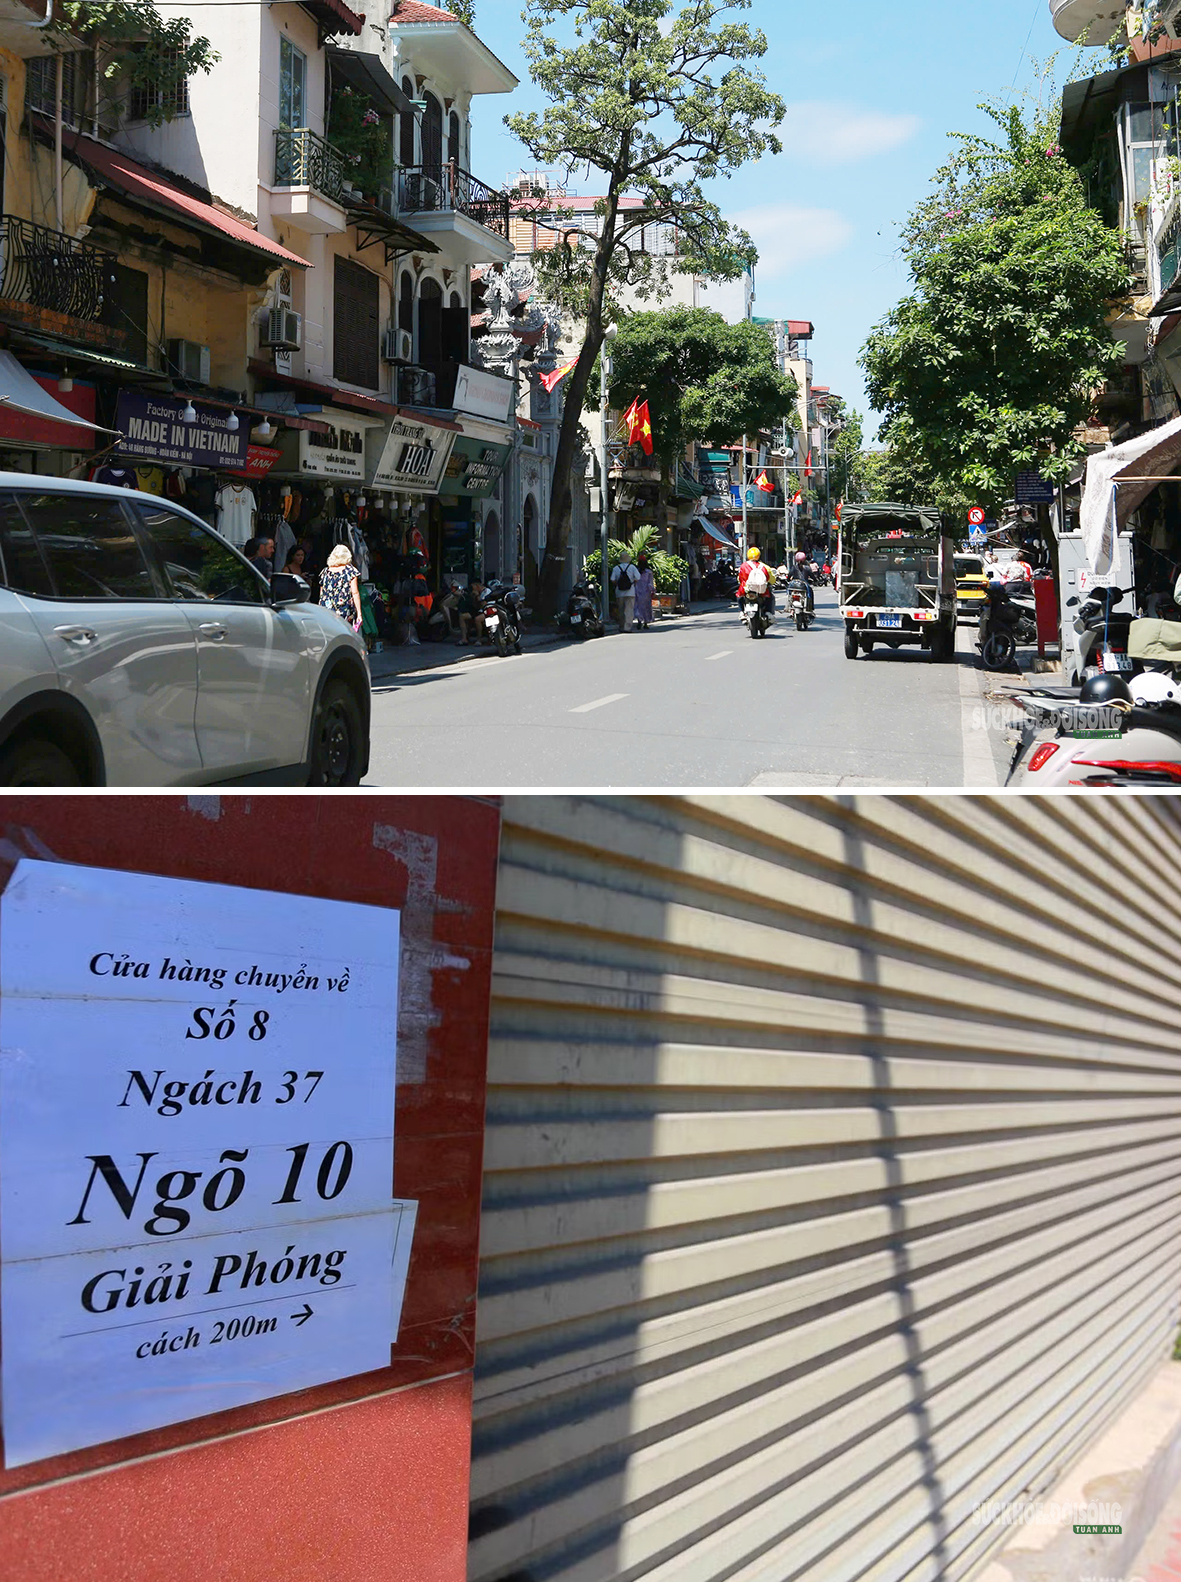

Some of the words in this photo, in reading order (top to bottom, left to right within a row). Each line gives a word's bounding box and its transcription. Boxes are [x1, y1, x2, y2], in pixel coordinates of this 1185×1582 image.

[147, 402, 176, 420] Factory
[128, 417, 168, 444] MADE
[171, 425, 186, 447] IN
[188, 428, 240, 454] VIETNAM
[466, 477, 490, 490] CENTRE
[90, 951, 150, 979] Cửa
[160, 958, 228, 990] hàng
[234, 963, 320, 994] chuyển
[325, 967, 352, 993] về
[185, 999, 237, 1041] Số
[247, 1011, 269, 1041] 8
[118, 1068, 263, 1116] Ngách
[275, 1070, 324, 1105] 37
[66, 1147, 249, 1236] Ngõ
[272, 1141, 354, 1204] 10
[80, 1261, 190, 1314] Giải
[207, 1245, 347, 1298] Phóng
[136, 1327, 200, 1361] cách
[209, 1315, 278, 1346] 200m
